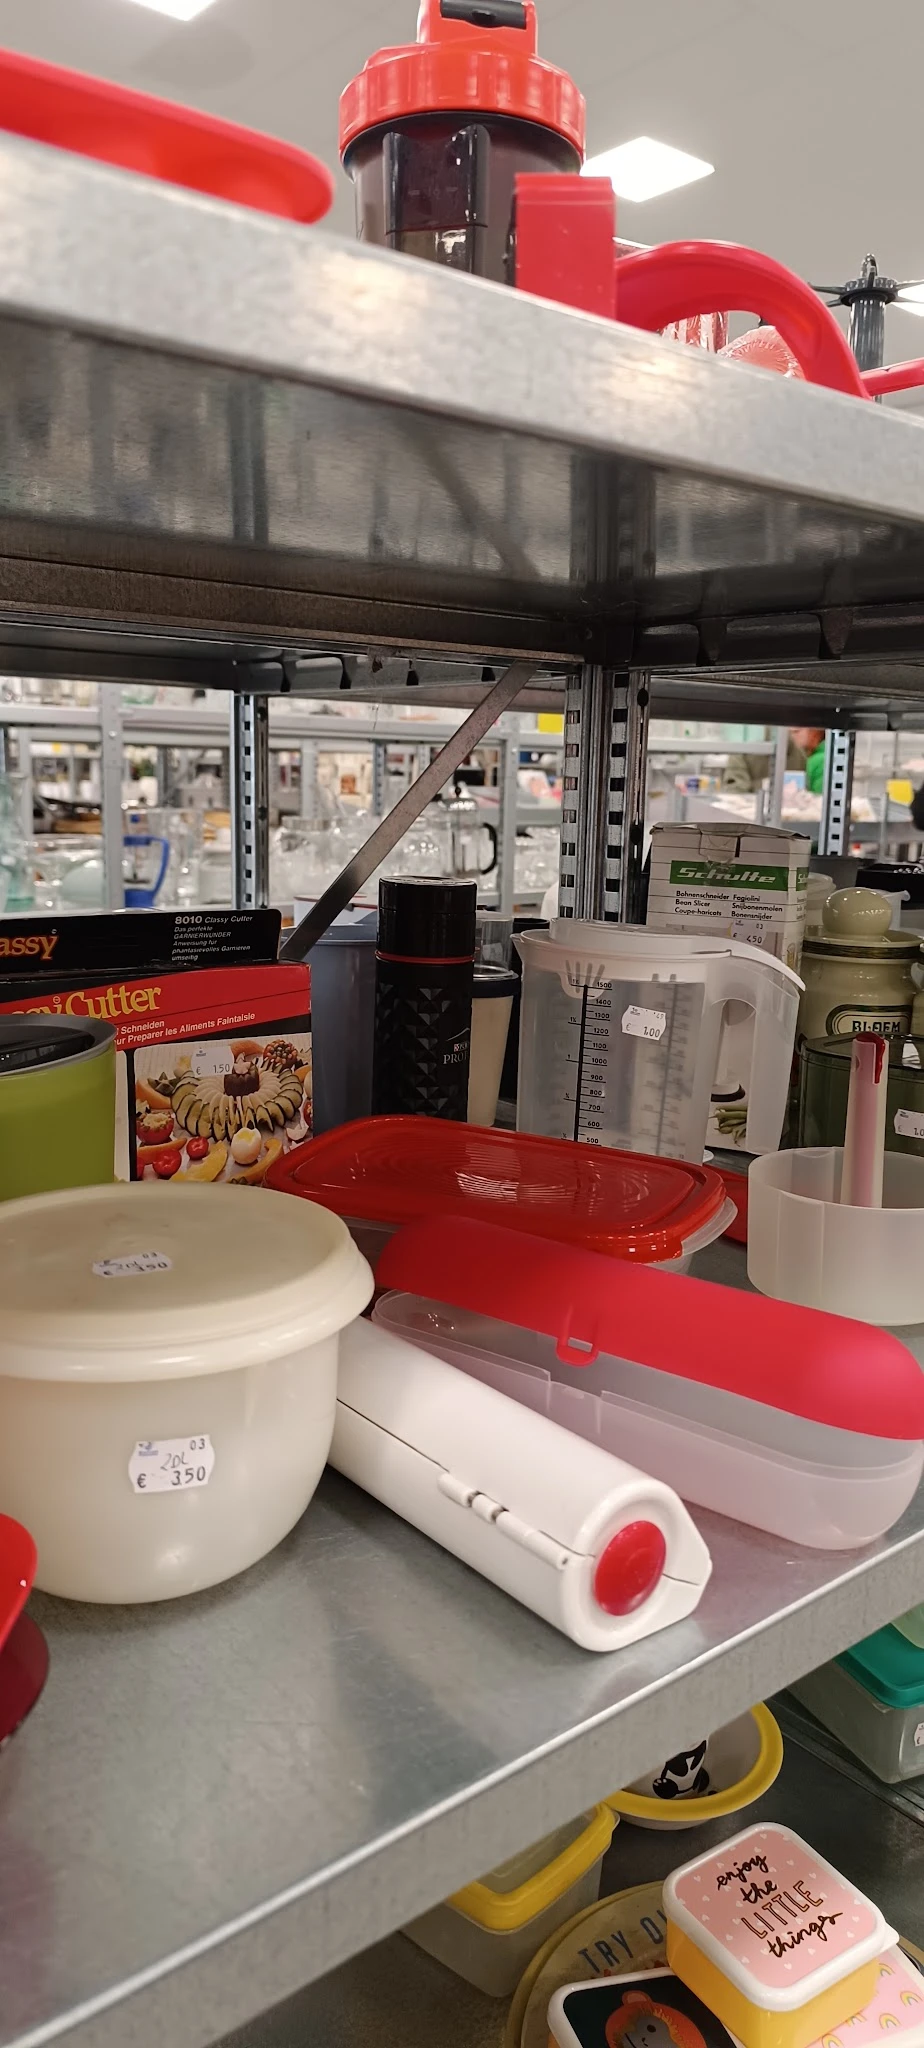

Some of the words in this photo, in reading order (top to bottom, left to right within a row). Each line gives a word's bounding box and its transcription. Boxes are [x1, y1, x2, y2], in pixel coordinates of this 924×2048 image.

[676, 867, 776, 884] Schulte
[675, 890, 730, 900] Bohnenschneider
[732, 894, 761, 903] Fagiolini
[731, 903, 783, 912] Snijbonenmolen
[174, 915, 203, 925] 8010
[204, 916, 229, 924] Classy
[731, 911, 773, 920] Bonensnijder
[173, 932, 232, 940] GARNIERWUNDER
[65, 985, 162, 1019] Cutter
[120, 1020, 165, 1036] Schneiden
[127, 1031, 163, 1044] Preparer
[165, 1027, 178, 1037] les
[179, 1020, 216, 1034] Aliments
[852, 1020, 901, 1033] BLOEM
[196, 1066, 202, 1075] €
[189, 1438, 206, 1450] 03
[136, 1473, 147, 1488] €
[716, 1855, 769, 1891] enjoy
[740, 1880, 778, 1904] the
[740, 1880, 824, 1939] LITTLE
[766, 1912, 843, 1958] things
[577, 1930, 634, 1973] TRY
